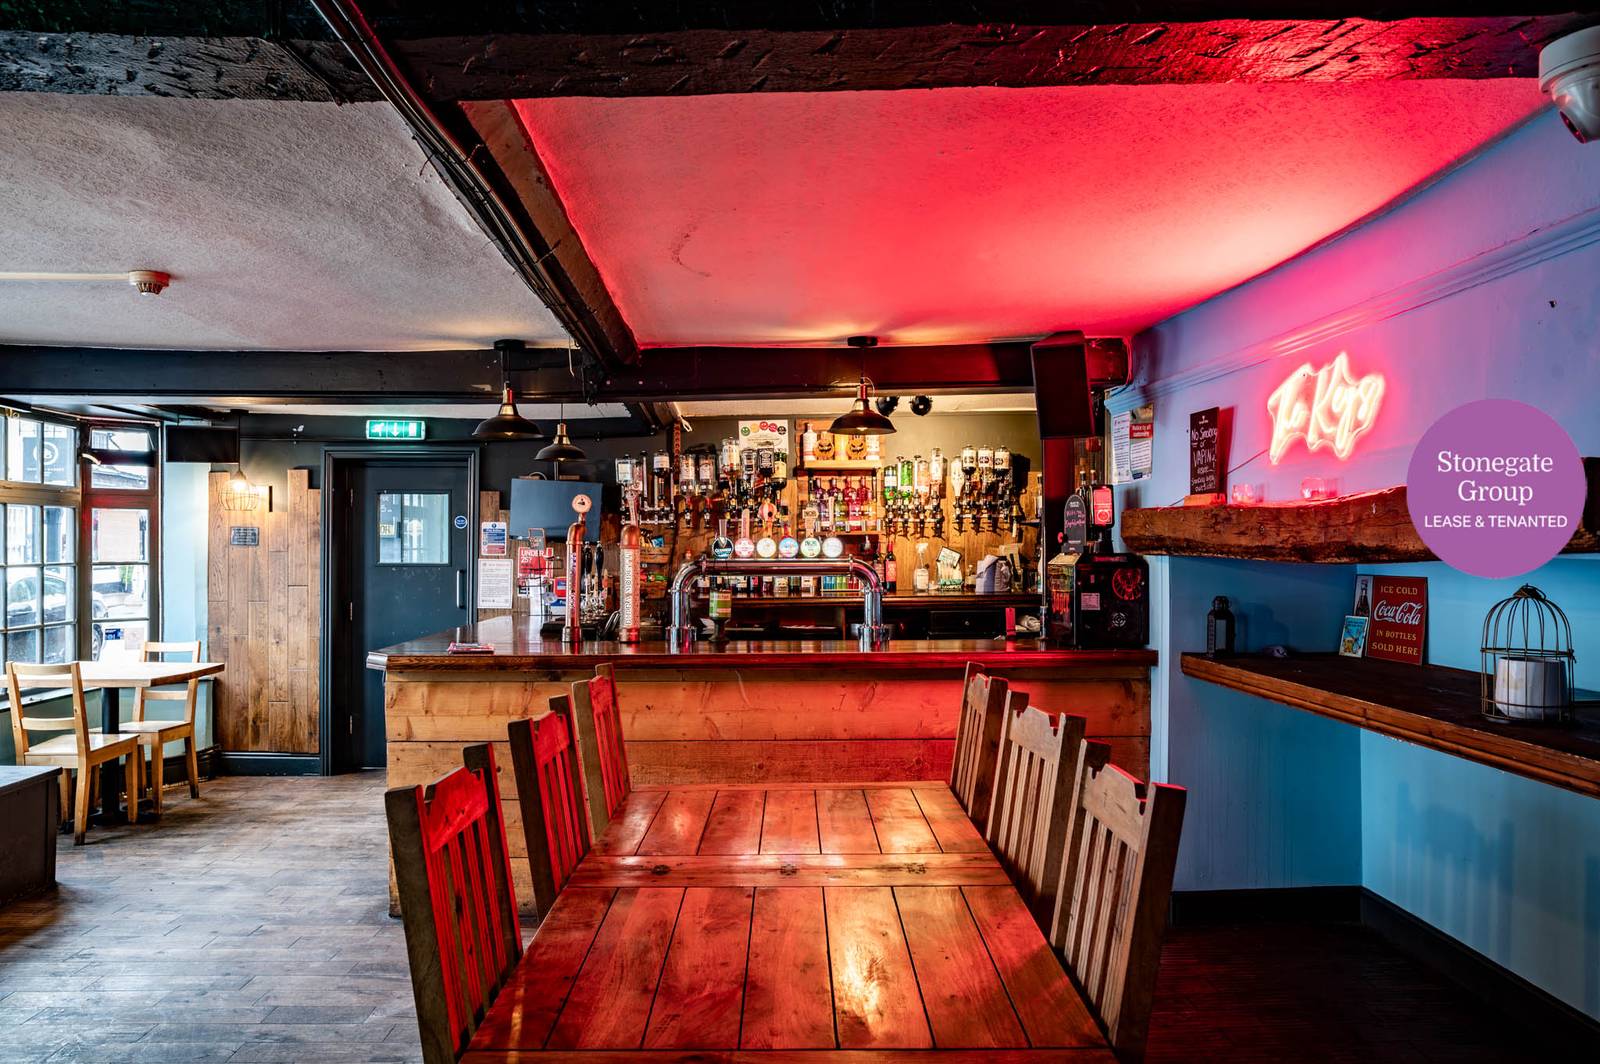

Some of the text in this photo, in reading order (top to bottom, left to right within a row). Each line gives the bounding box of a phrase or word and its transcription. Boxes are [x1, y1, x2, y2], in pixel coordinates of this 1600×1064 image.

[1380, 585, 1418, 595] ICE COLD
[1376, 629, 1417, 641] IN BOTTLES
[1371, 642, 1418, 656] SOLD HERE
